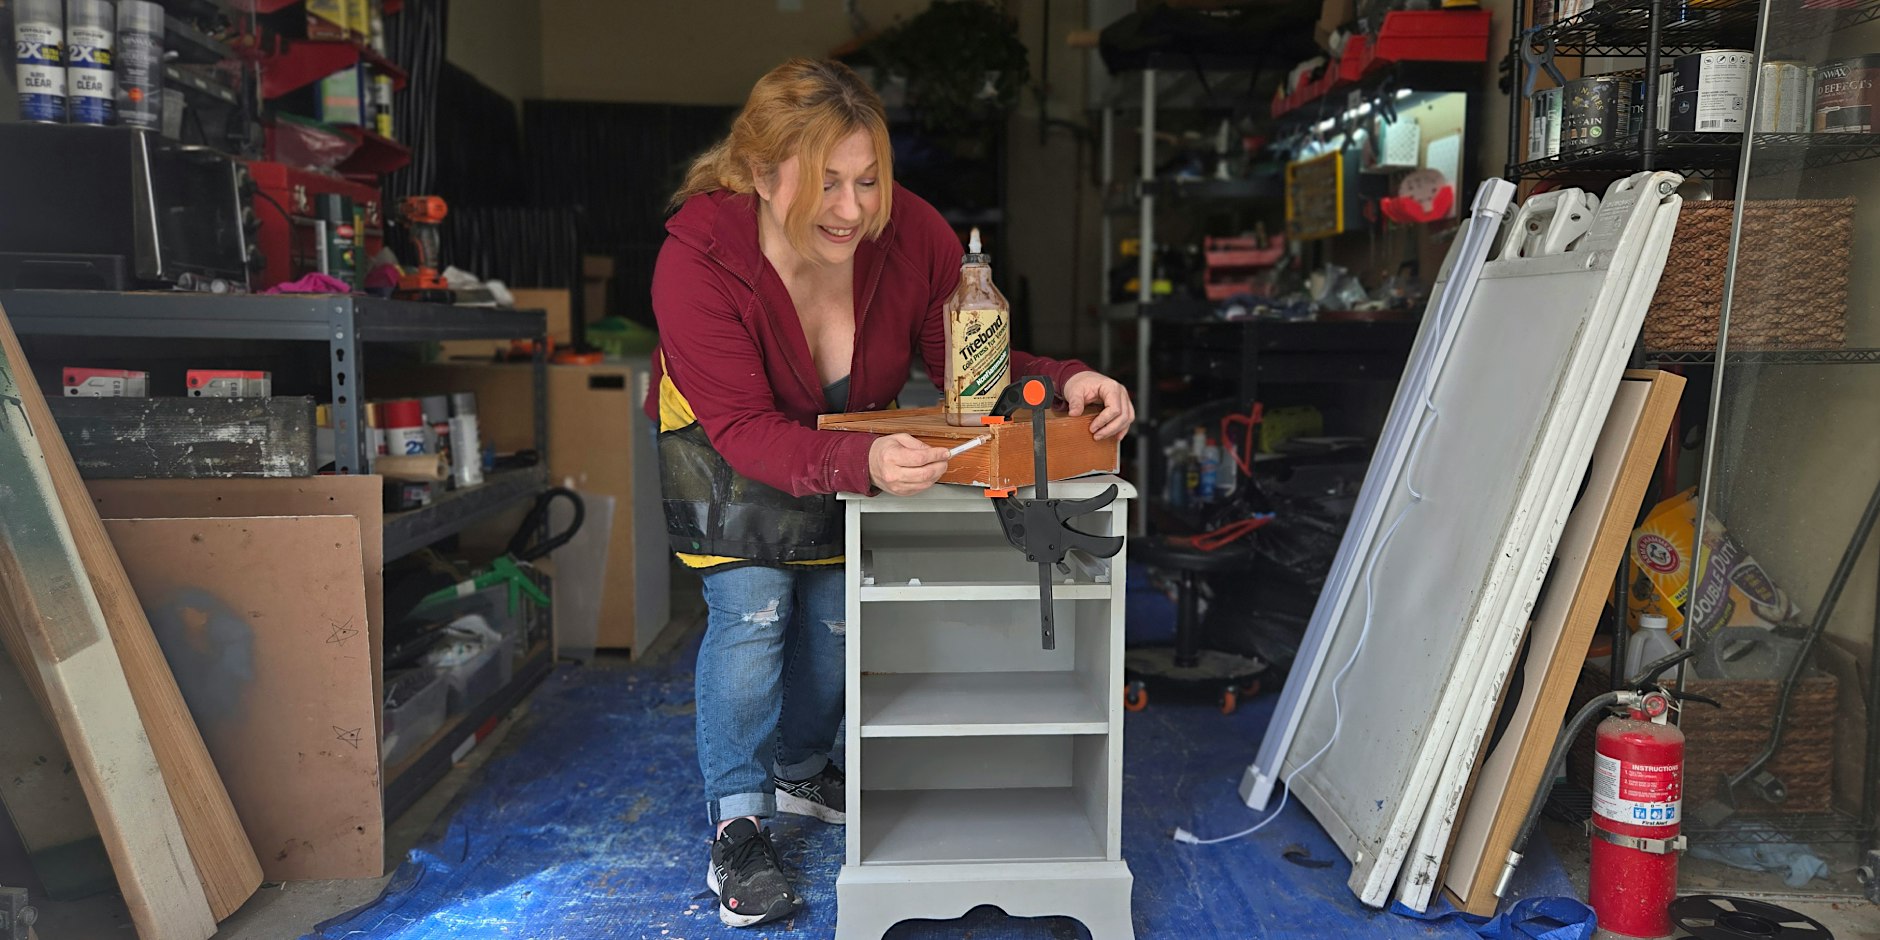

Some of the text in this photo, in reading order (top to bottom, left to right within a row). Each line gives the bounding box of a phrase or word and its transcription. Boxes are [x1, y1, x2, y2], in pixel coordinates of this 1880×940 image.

[17, 42, 42, 60] 2X
[69, 45, 95, 62] 2X
[25, 78, 52, 88] CLEAR
[77, 80, 103, 91] CLEAR
[1824, 80, 1873, 94] EFFECTS
[959, 314, 1003, 360] Titebond
[1642, 536, 1673, 552] HAMMER
[1711, 540, 1738, 575] DUTY
[1632, 764, 1679, 772] INSTRUCTIONS
